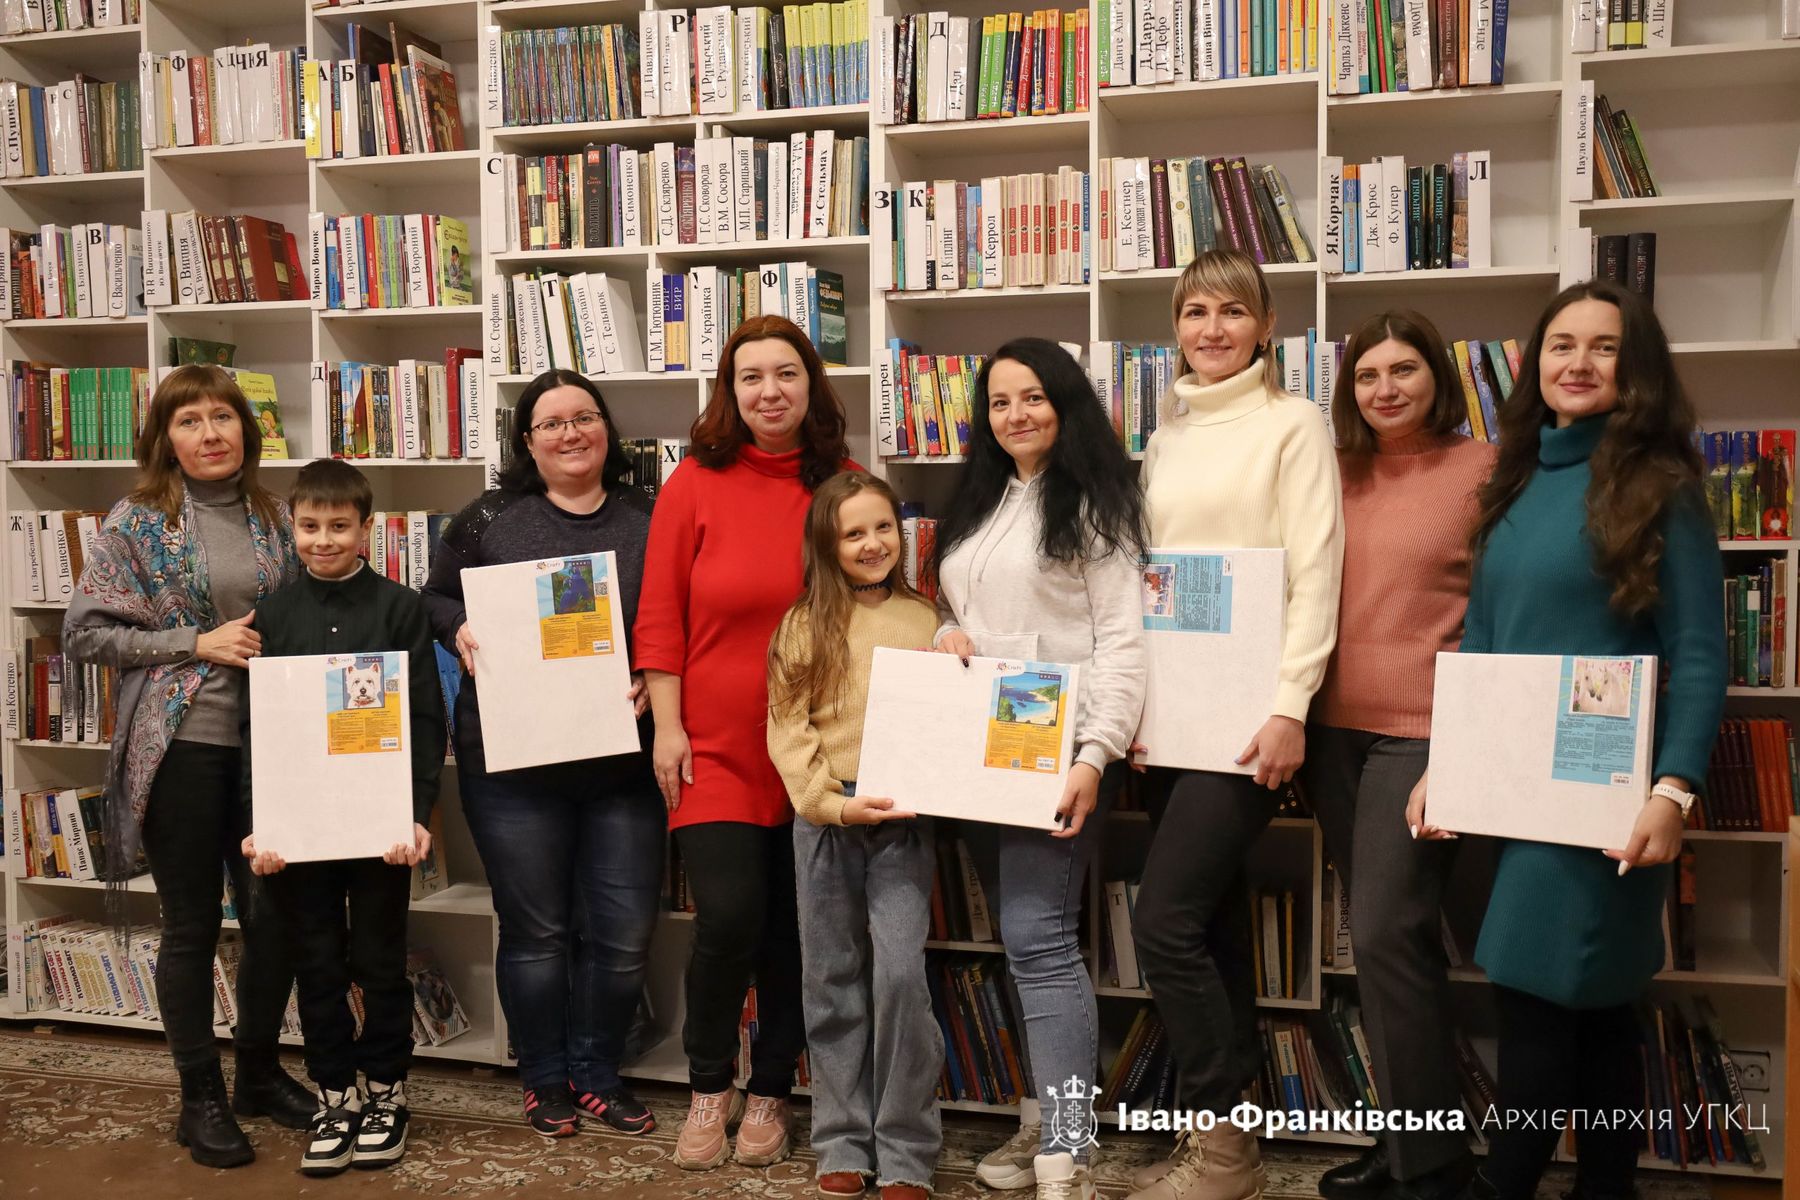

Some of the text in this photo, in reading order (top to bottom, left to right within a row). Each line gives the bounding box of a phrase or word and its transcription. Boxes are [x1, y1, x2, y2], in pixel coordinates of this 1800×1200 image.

[671, 14, 686, 32] Р
[929, 21, 946, 40] Д
[1156, 17, 1169, 53] Дефо
[1202, 13, 1213, 71] Діана Вінн
[1338, 3, 1354, 80] Чарльз Діккенс
[1408, 1, 1424, 37] Дюма
[1476, 19, 1489, 51] Енде
[1579, 10, 1591, 21] Р.
[1652, 26, 1664, 39] А.
[172, 55, 185, 72] Ф
[236, 54, 248, 70] Ч
[255, 50, 269, 67] Я
[342, 65, 354, 82] Б
[488, 39, 498, 111] М. Павленко
[643, 27, 656, 99] Д. Павличко
[700, 24, 715, 103] М. Рильський
[715, 14, 728, 99] С. Руданський
[1113, 36, 1124, 71] Данте
[63, 89, 72, 99] С
[742, 89, 752, 102] В.
[1576, 95, 1587, 175] Пауло Коельйо
[486, 158, 502, 175] С
[737, 149, 752, 231] М.П. Старицький
[815, 150, 828, 226] Я. Стельмах
[1468, 160, 1488, 181] Л
[624, 158, 635, 236] В. Симоненко
[660, 161, 673, 236] С.Д. Скляренко
[699, 164, 711, 234] Г.С. Сковорода
[717, 163, 730, 232] В.М. Сосюра
[874, 190, 890, 209] З
[909, 189, 924, 208] К
[1120, 180, 1134, 246] Е. Кестнер
[1326, 174, 1342, 256] Я.Корчак
[1365, 183, 1380, 248] Дж. Крюс
[1387, 185, 1402, 244] Ф. Купер
[1409, 178, 1420, 222] ЗВІРОБІЙ
[1434, 176, 1444, 219] ЗВІРОБІЙ
[90, 229, 101, 246] В
[185, 218, 203, 282] Вінграновський
[343, 227, 356, 295] Л. Воронина
[409, 226, 423, 291] М. Вороний
[940, 227, 954, 281] Р. Кіплінг
[984, 215, 998, 276] Л. Керрол
[1136, 207, 1150, 258] Артур Конан
[113, 243, 124, 310] С. Васильченко
[180, 238, 193, 297] О. Вишня
[311, 230, 321, 300] Марко Вовчок
[543, 279, 557, 297] Т
[761, 270, 778, 288] Ф
[527, 283, 545, 368] В. Сухомлинський
[575, 287, 596, 358] М. Трублаїні
[596, 291, 616, 354] С. Тельнюк
[649, 281, 662, 361] Г.М. Тютюнник
[674, 286, 682, 311] ВИР
[700, 287, 714, 363] Л. Українка
[489, 293, 502, 364] В.С. Стефаник
[312, 367, 324, 382] Д
[1317, 354, 1331, 415] Міцкевич
[403, 373, 416, 450] О.П. Довженко
[468, 372, 480, 449] О.В. Донченко
[879, 364, 892, 445] А. Ліндгрен
[663, 445, 677, 463] Х
[10, 516, 22, 531] Ж
[413, 521, 424, 530] В.
[27, 521, 39, 592] П. Загребельний
[56, 529, 71, 594] О. Іваненко
[6, 662, 17, 731] Ліна Костенко
[10, 810, 22, 856] В. Малик
[68, 813, 88, 872] Панас Мирний
[1111, 894, 1122, 906] Т
[1336, 943, 1349, 956] П.
